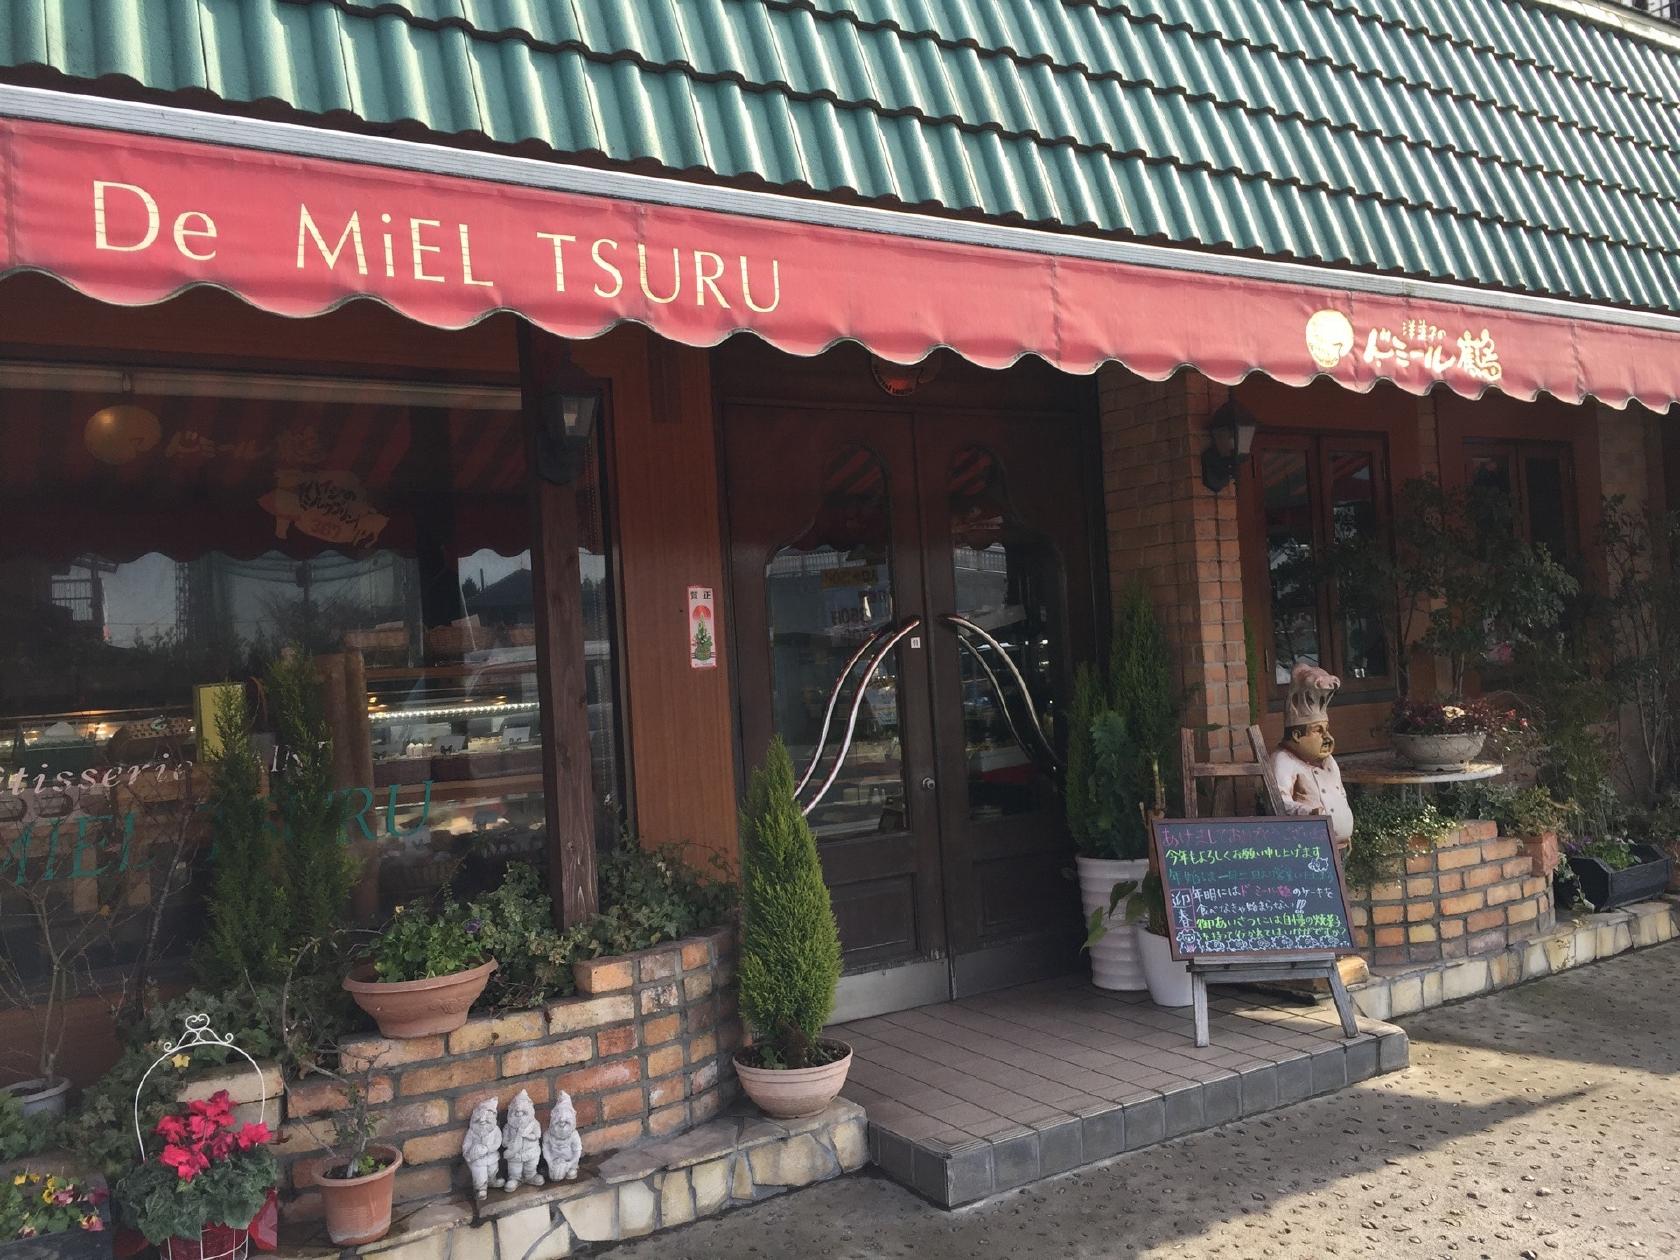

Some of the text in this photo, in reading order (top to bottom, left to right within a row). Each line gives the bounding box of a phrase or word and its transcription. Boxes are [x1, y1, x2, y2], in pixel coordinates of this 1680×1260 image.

[93, 180, 780, 313] De MiEL TSURU
